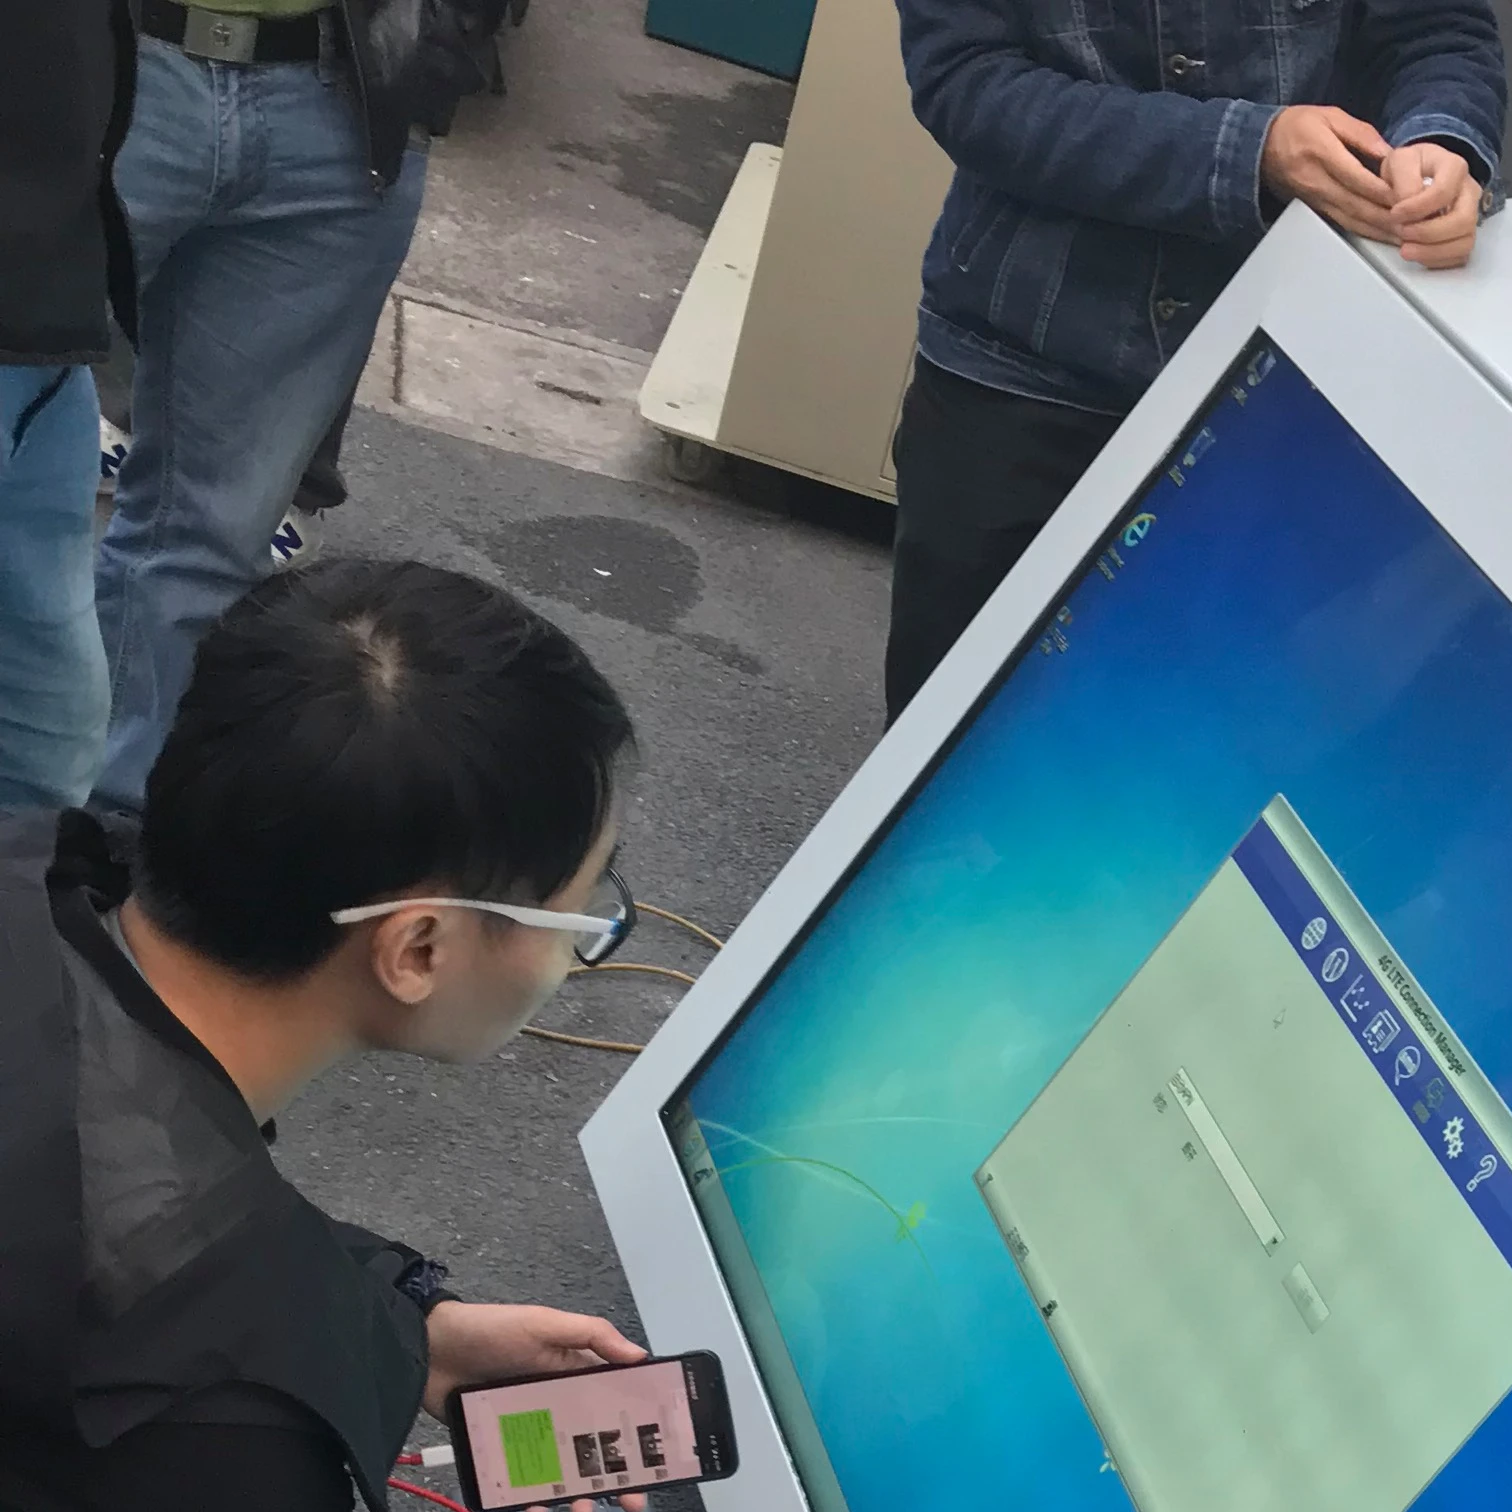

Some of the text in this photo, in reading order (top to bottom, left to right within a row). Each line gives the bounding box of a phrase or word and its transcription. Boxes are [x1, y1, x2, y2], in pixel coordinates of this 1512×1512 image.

[1378, 954, 1467, 1077] 4G LTE Connection Manager
